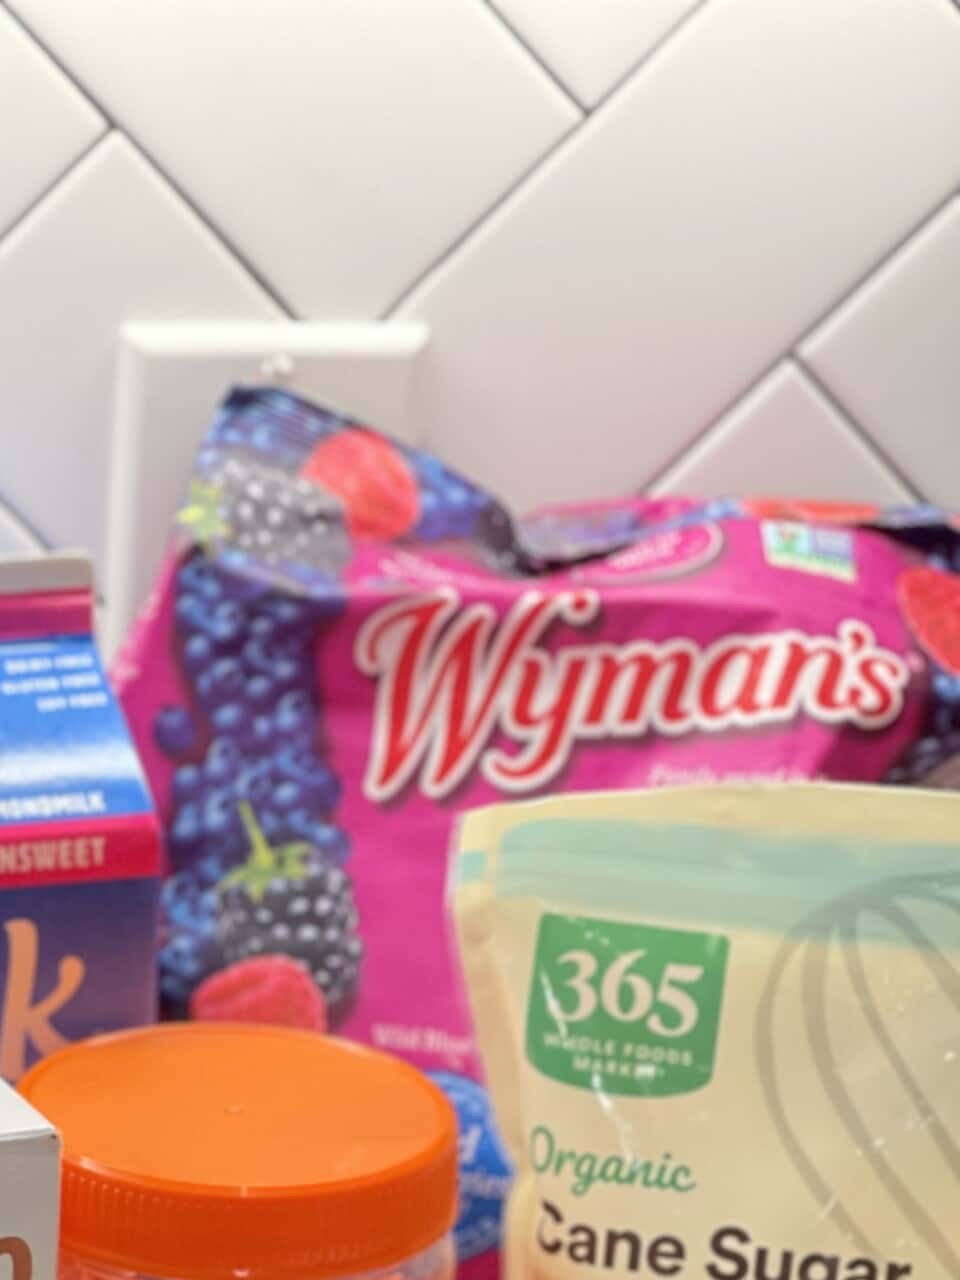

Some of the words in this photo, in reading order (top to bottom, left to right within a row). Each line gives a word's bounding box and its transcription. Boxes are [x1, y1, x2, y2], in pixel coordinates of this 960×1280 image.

[355, 588, 910, 801] Wyman's
[556, 948, 704, 1038] 365
[623, 1043, 693, 1067] FOODS
[529, 1126, 698, 1199] Organic
[535, 1201, 687, 1277] Cane
